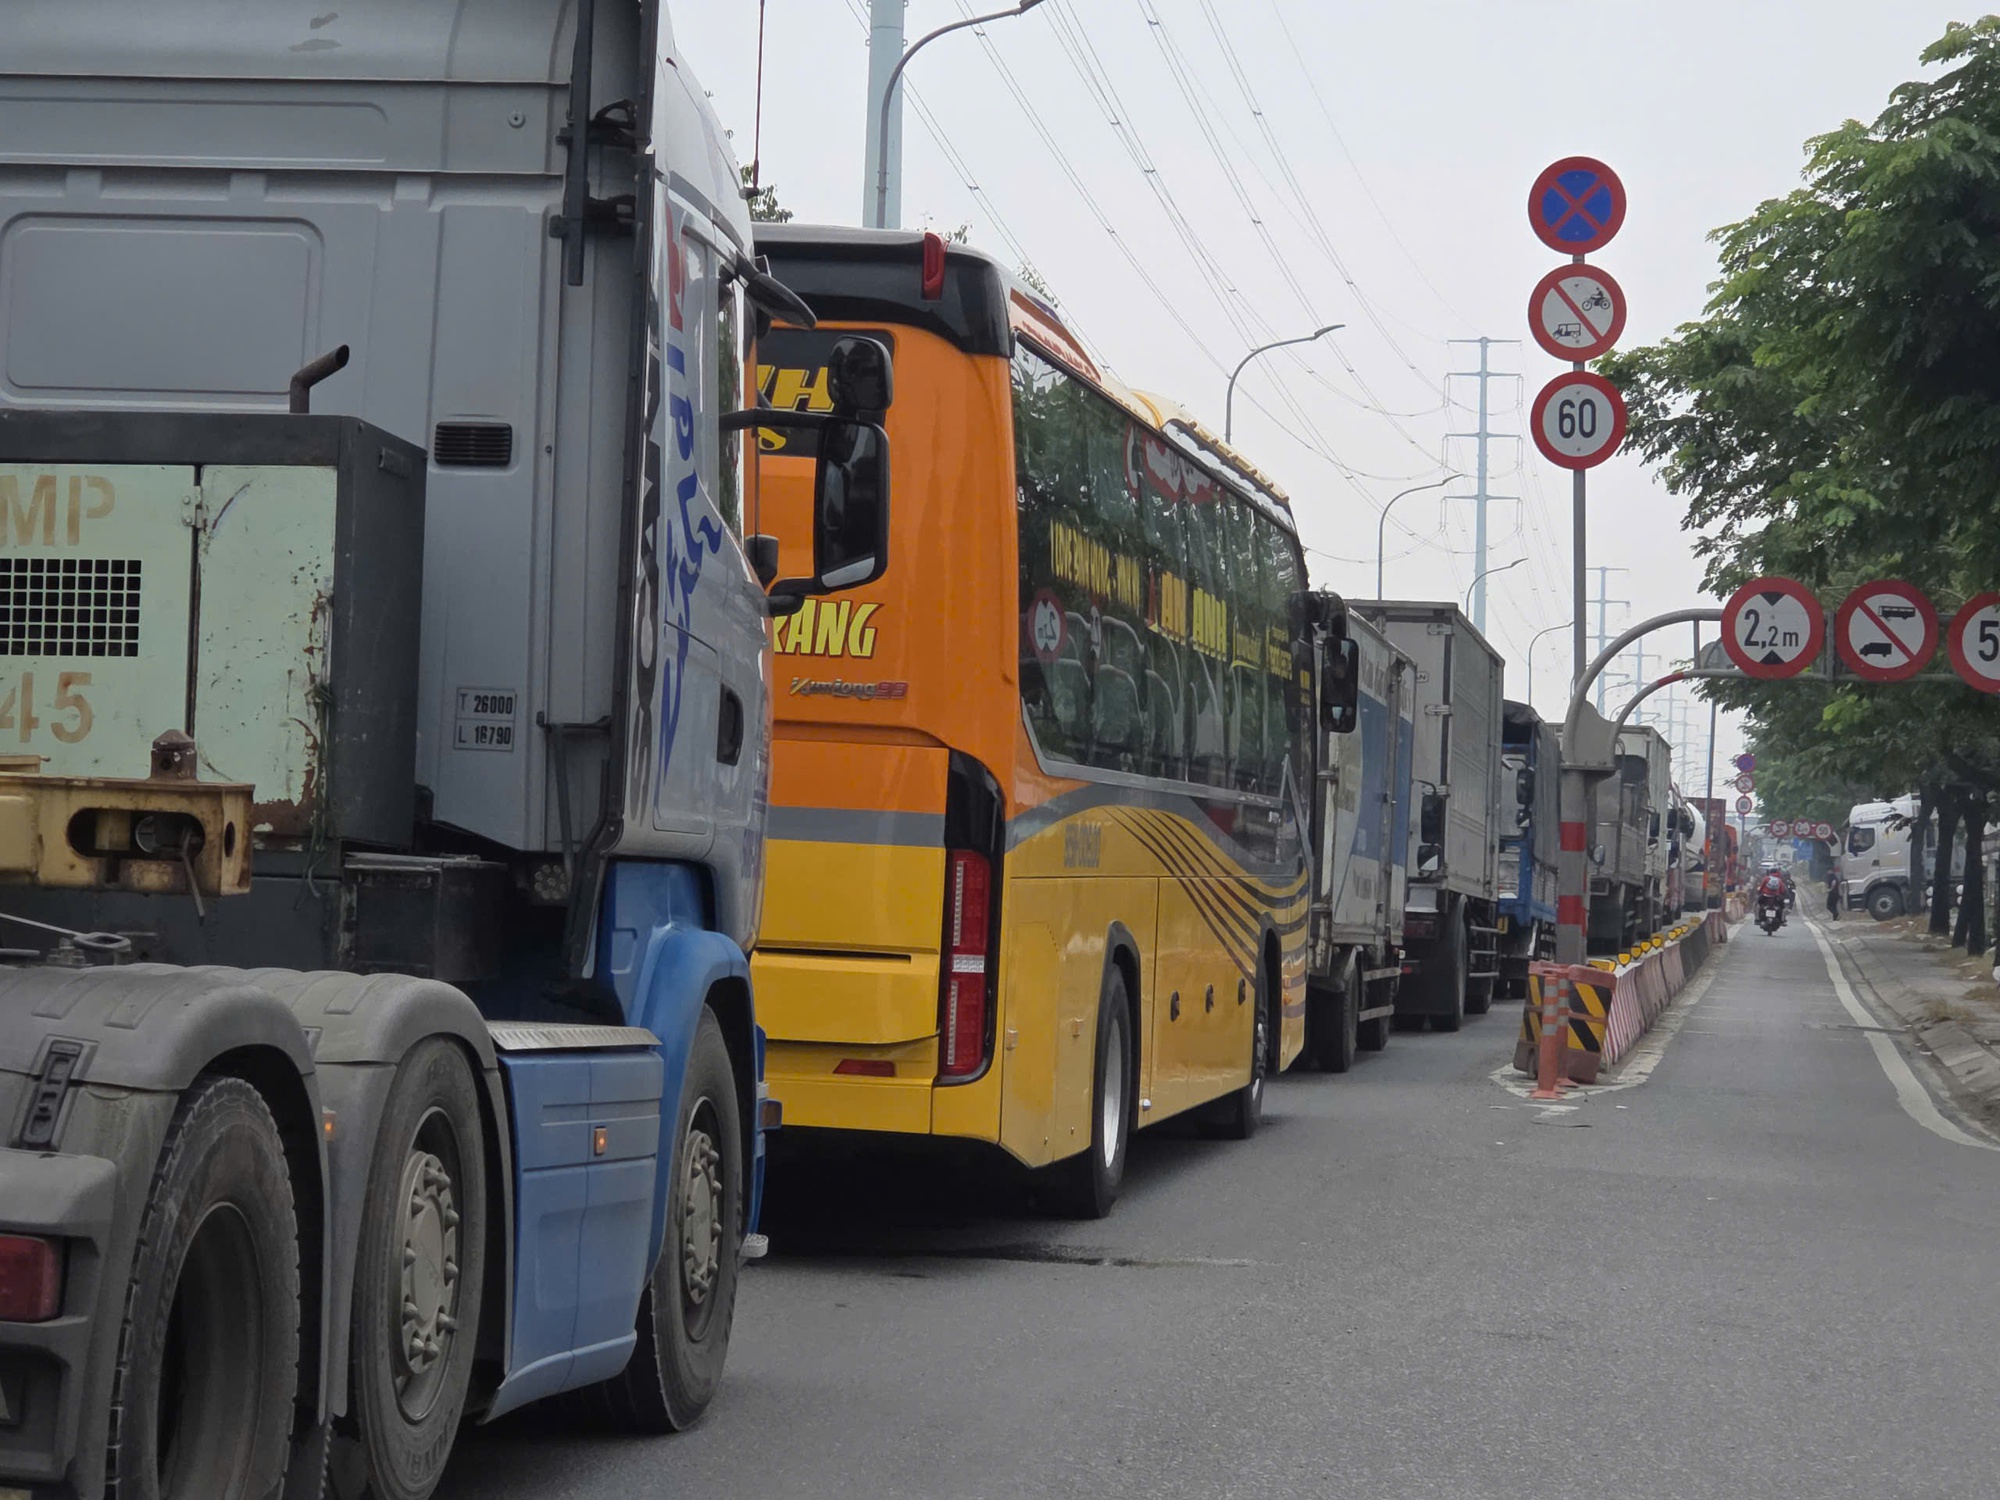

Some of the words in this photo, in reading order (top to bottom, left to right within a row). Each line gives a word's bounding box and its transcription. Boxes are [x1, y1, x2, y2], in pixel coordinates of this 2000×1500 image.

[1558, 398, 1597, 439] 60
[1978, 619, 2000, 662] 5
[459, 693, 468, 712] T
[473, 694, 513, 715] 26000
[458, 725, 467, 743] L
[474, 725, 512, 745] 16790
